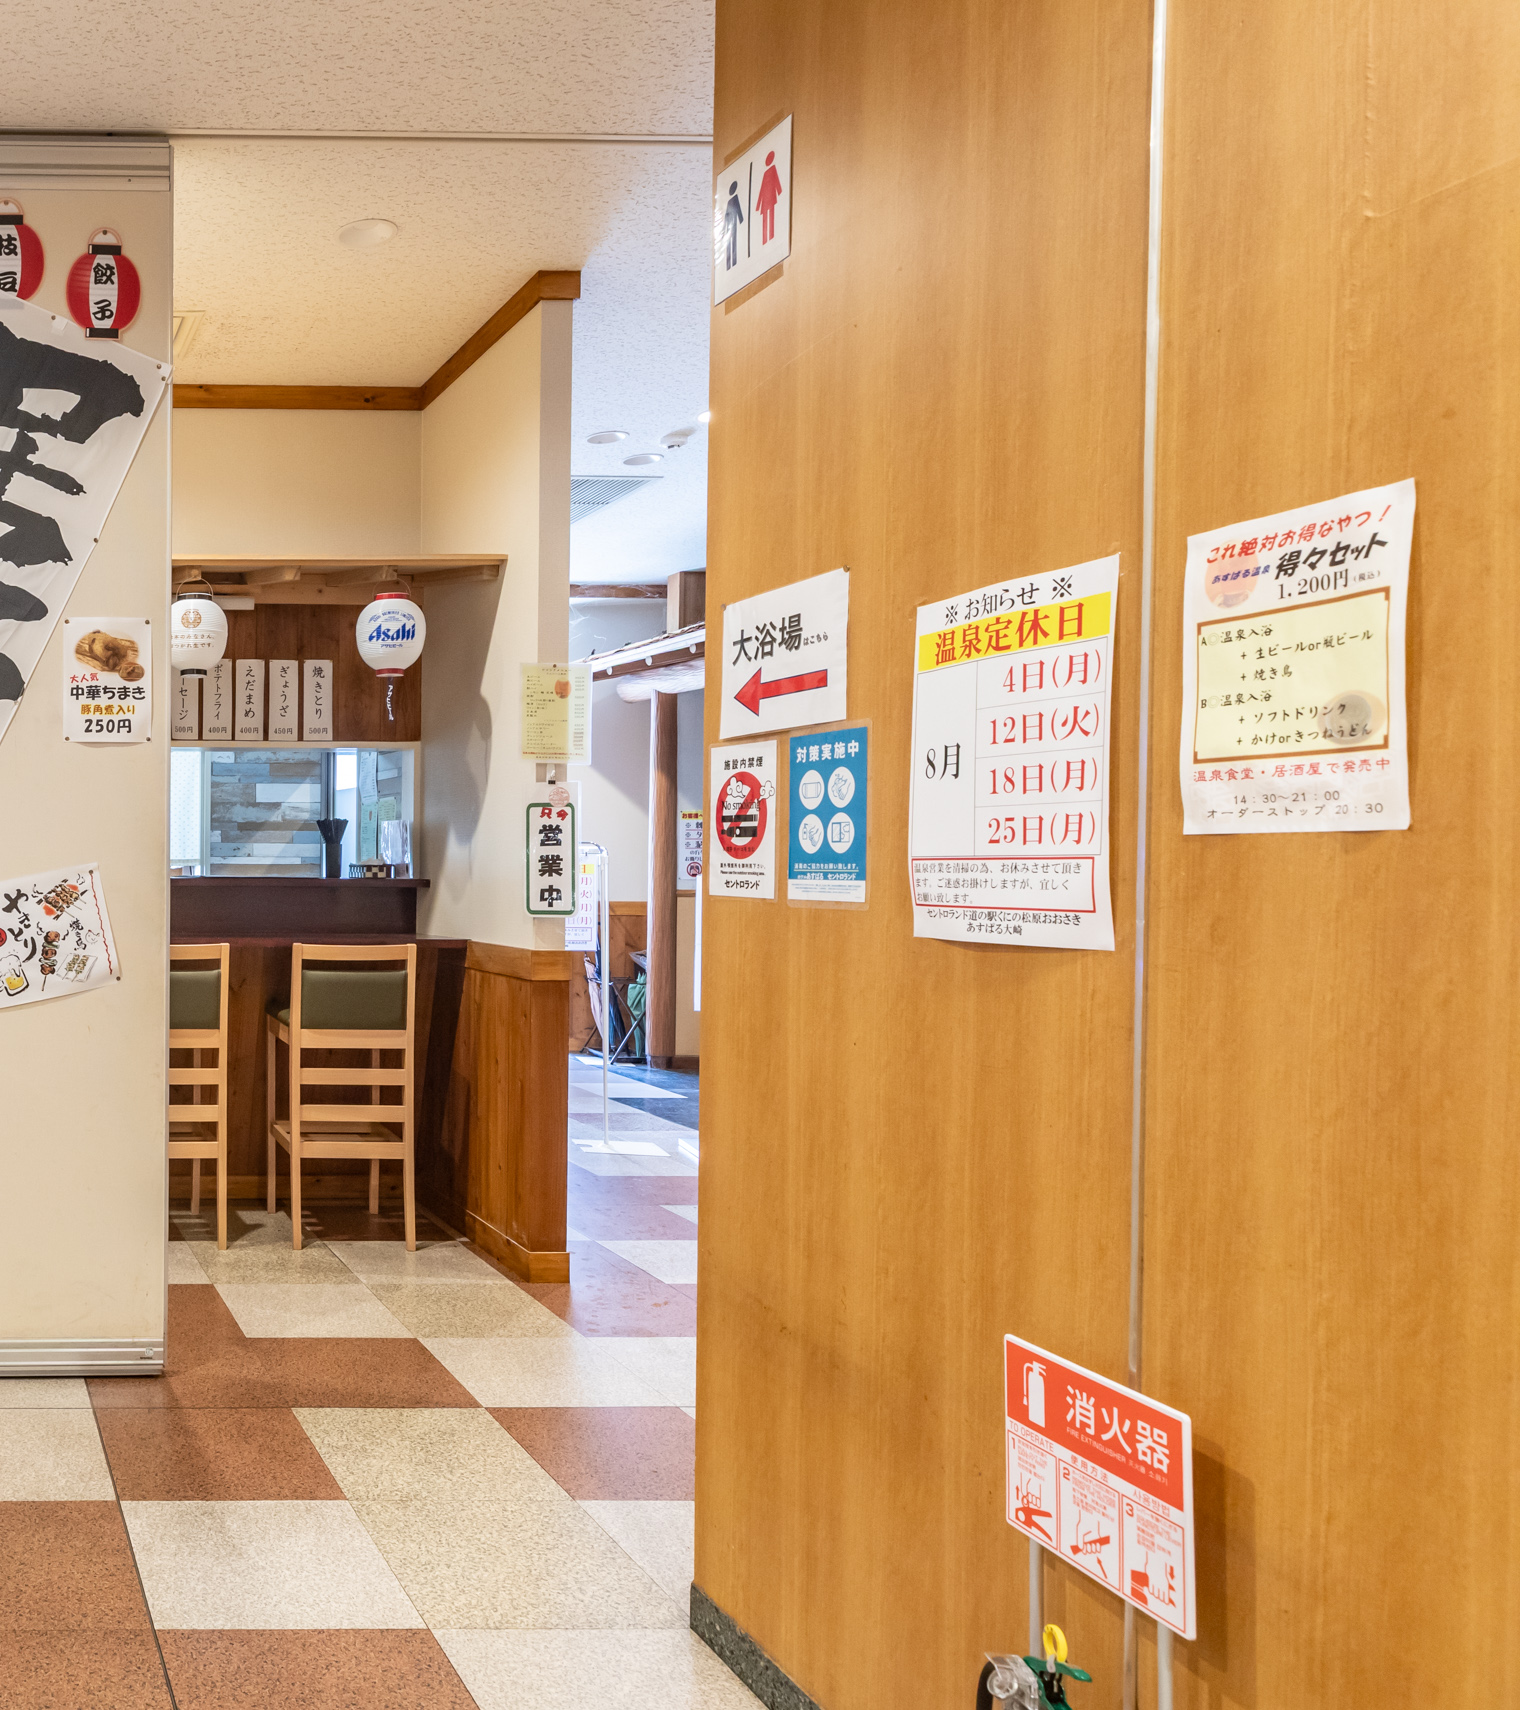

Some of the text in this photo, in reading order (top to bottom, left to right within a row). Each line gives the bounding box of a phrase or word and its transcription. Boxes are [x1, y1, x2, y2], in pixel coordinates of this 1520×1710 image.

[92, 262, 115, 321] 餃子
[1274, 532, 1388, 580] 得々セット
[1211, 564, 1271, 584] あすばる温泉
[964, 583, 1040, 621] お知らせ
[368, 622, 416, 642] Asahi
[935, 602, 1084, 666] 温泉定休日
[70, 673, 99, 684] 大人気
[1003, 649, 1101, 693] 4日(月)
[1253, 665, 1293, 681] 焼き鳥
[70, 685, 146, 700] 中華ちまき
[179, 678, 188, 720] ーセージ
[244, 665, 256, 718] えだまめ
[279, 665, 290, 717] ぎょうざ
[312, 666, 325, 720] 焼きとり
[80, 704, 135, 715] 豚角煮入り
[990, 703, 1099, 745] 12日(火)
[1254, 703, 1346, 724] ソフトドリンク
[84, 719, 132, 733] 250円
[175, 726, 193, 734] 500円
[724, 756, 763, 770] 施設内禁煙
[796, 740, 859, 763] 対策実施中
[925, 742, 961, 781] 8月
[989, 757, 1098, 796] 18日(月)
[722, 799, 761, 811] No smoking
[1207, 804, 1325, 819] オーダーストップ
[988, 811, 1096, 847] 25日(月)
[538, 824, 563, 907] 営業中
[724, 879, 760, 890] セントロランド
[916, 893, 974, 904] お願い致します。
[2, 889, 37, 963] やきとり
[966, 922, 1023, 936] あすばる大崎
[1009, 1420, 1054, 1452] TO OPERATE
[1066, 1384, 1170, 1475] 消火器
[1066, 1426, 1127, 1464] FIRE EXTINGUISHER
[1070, 1454, 1109, 1483] 使用方法
